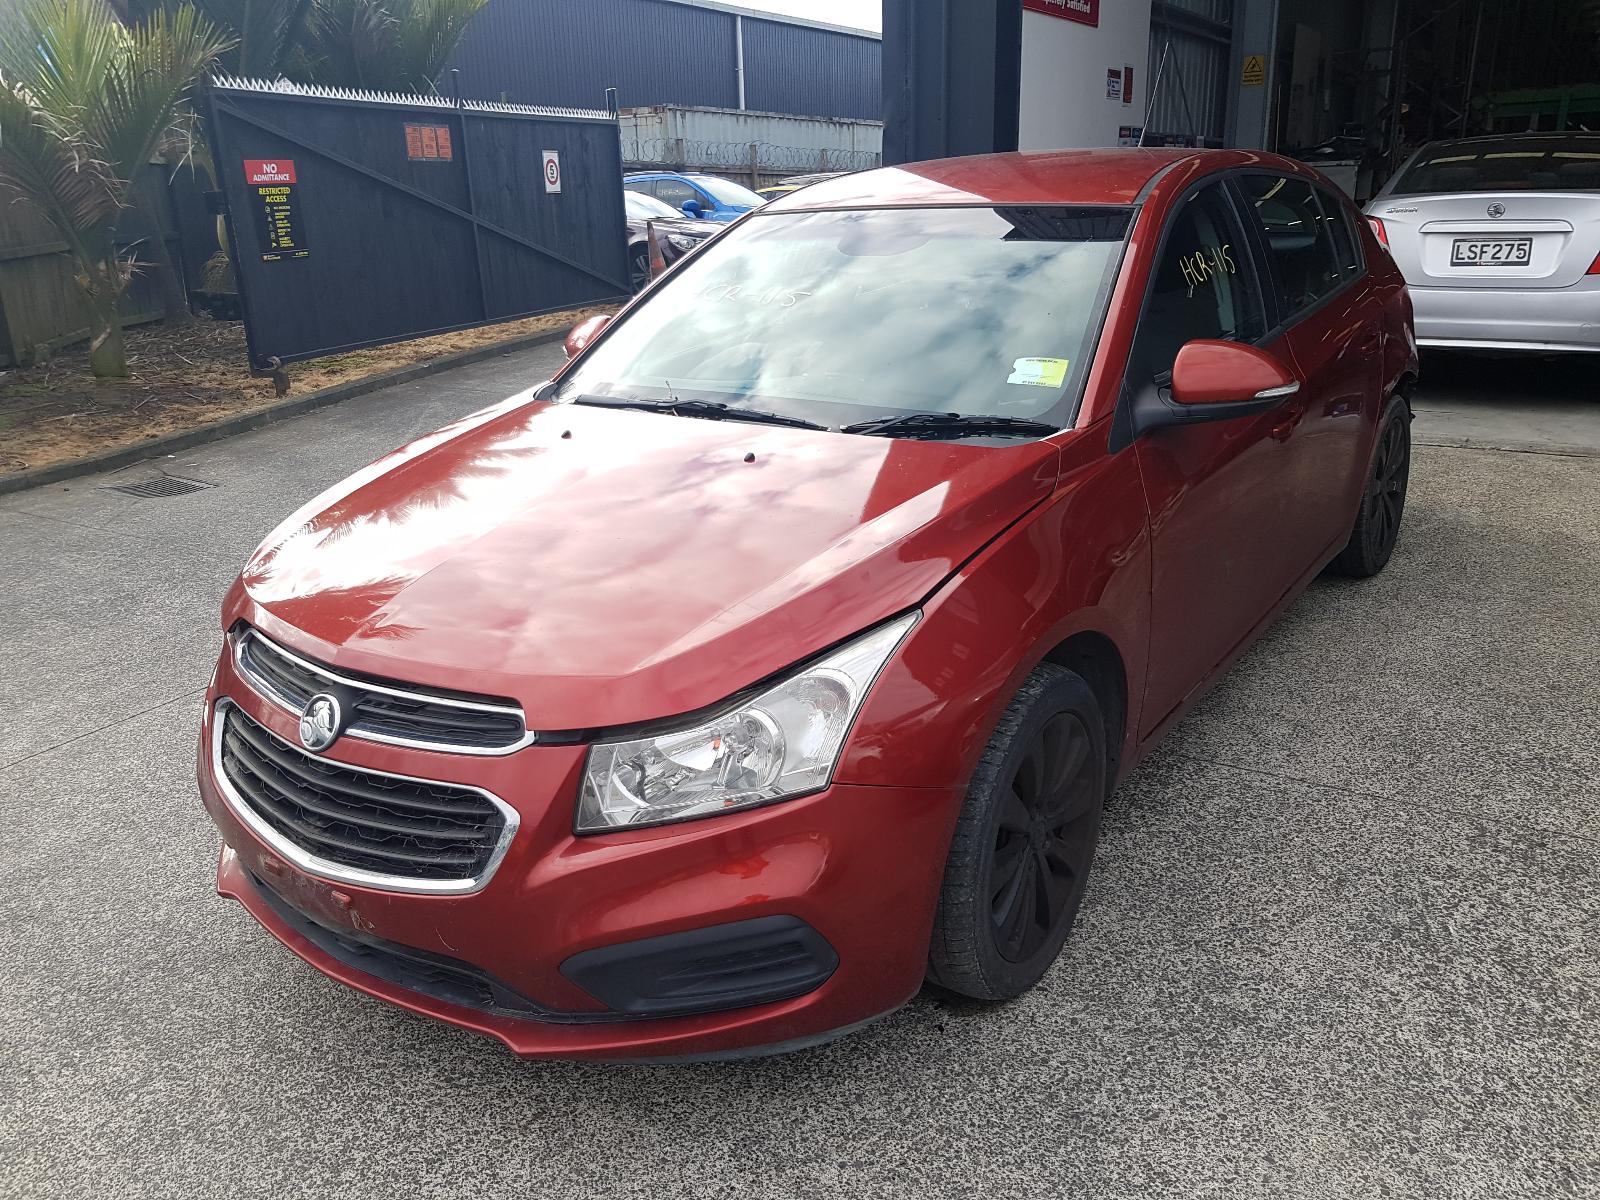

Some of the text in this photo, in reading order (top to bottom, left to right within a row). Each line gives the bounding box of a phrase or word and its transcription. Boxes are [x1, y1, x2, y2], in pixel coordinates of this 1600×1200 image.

[1067, 0, 1090, 13] Satisfied
[263, 164, 277, 173] NO
[550, 165, 554, 175] 5
[1455, 243, 1527, 260] LSF275
